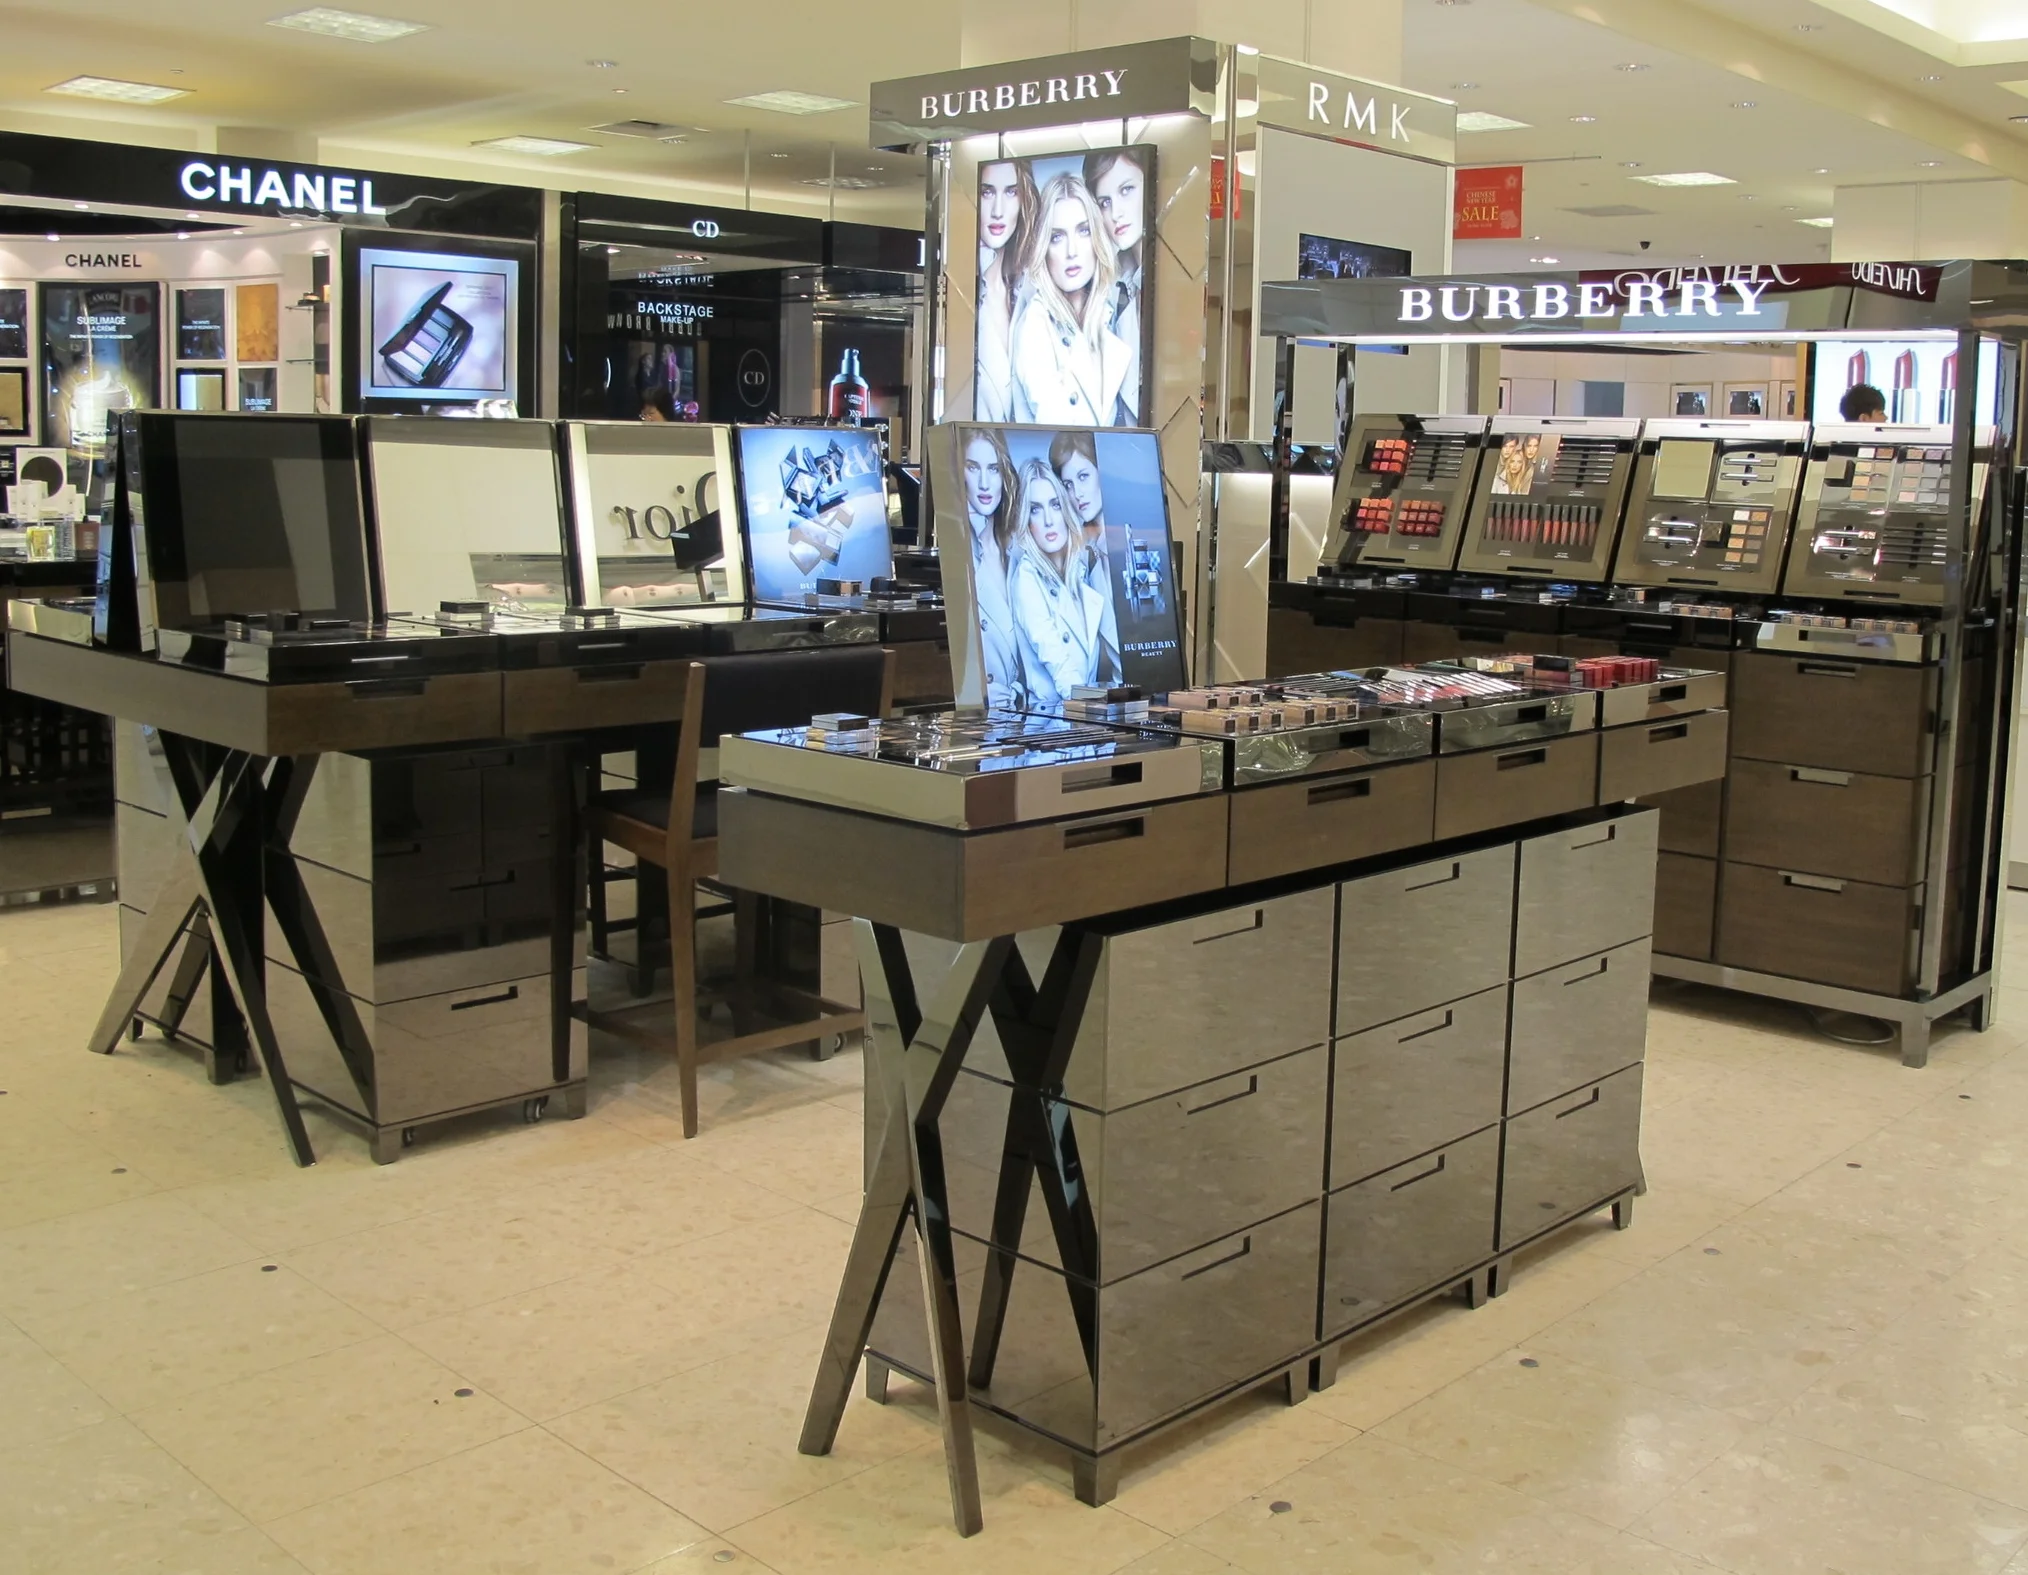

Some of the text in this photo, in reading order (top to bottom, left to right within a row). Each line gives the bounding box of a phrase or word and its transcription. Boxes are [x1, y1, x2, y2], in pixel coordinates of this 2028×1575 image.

[919, 68, 1129, 121] BURBERRY
[1307, 81, 1412, 144] RMK
[180, 161, 388, 217] CHANEL
[1461, 205, 1500, 221] SALE
[692, 219, 720, 239] CD
[64, 253, 143, 268] CHANEL
[1397, 277, 1776, 323] BURBERRY
[637, 301, 714, 318] BACKSTAGE
[76, 315, 127, 325] SUBLIMAGE
[660, 315, 694, 325] MAKE-UP
[743, 372, 765, 385] CD
[1124, 640, 1177, 651] BURBERRY
